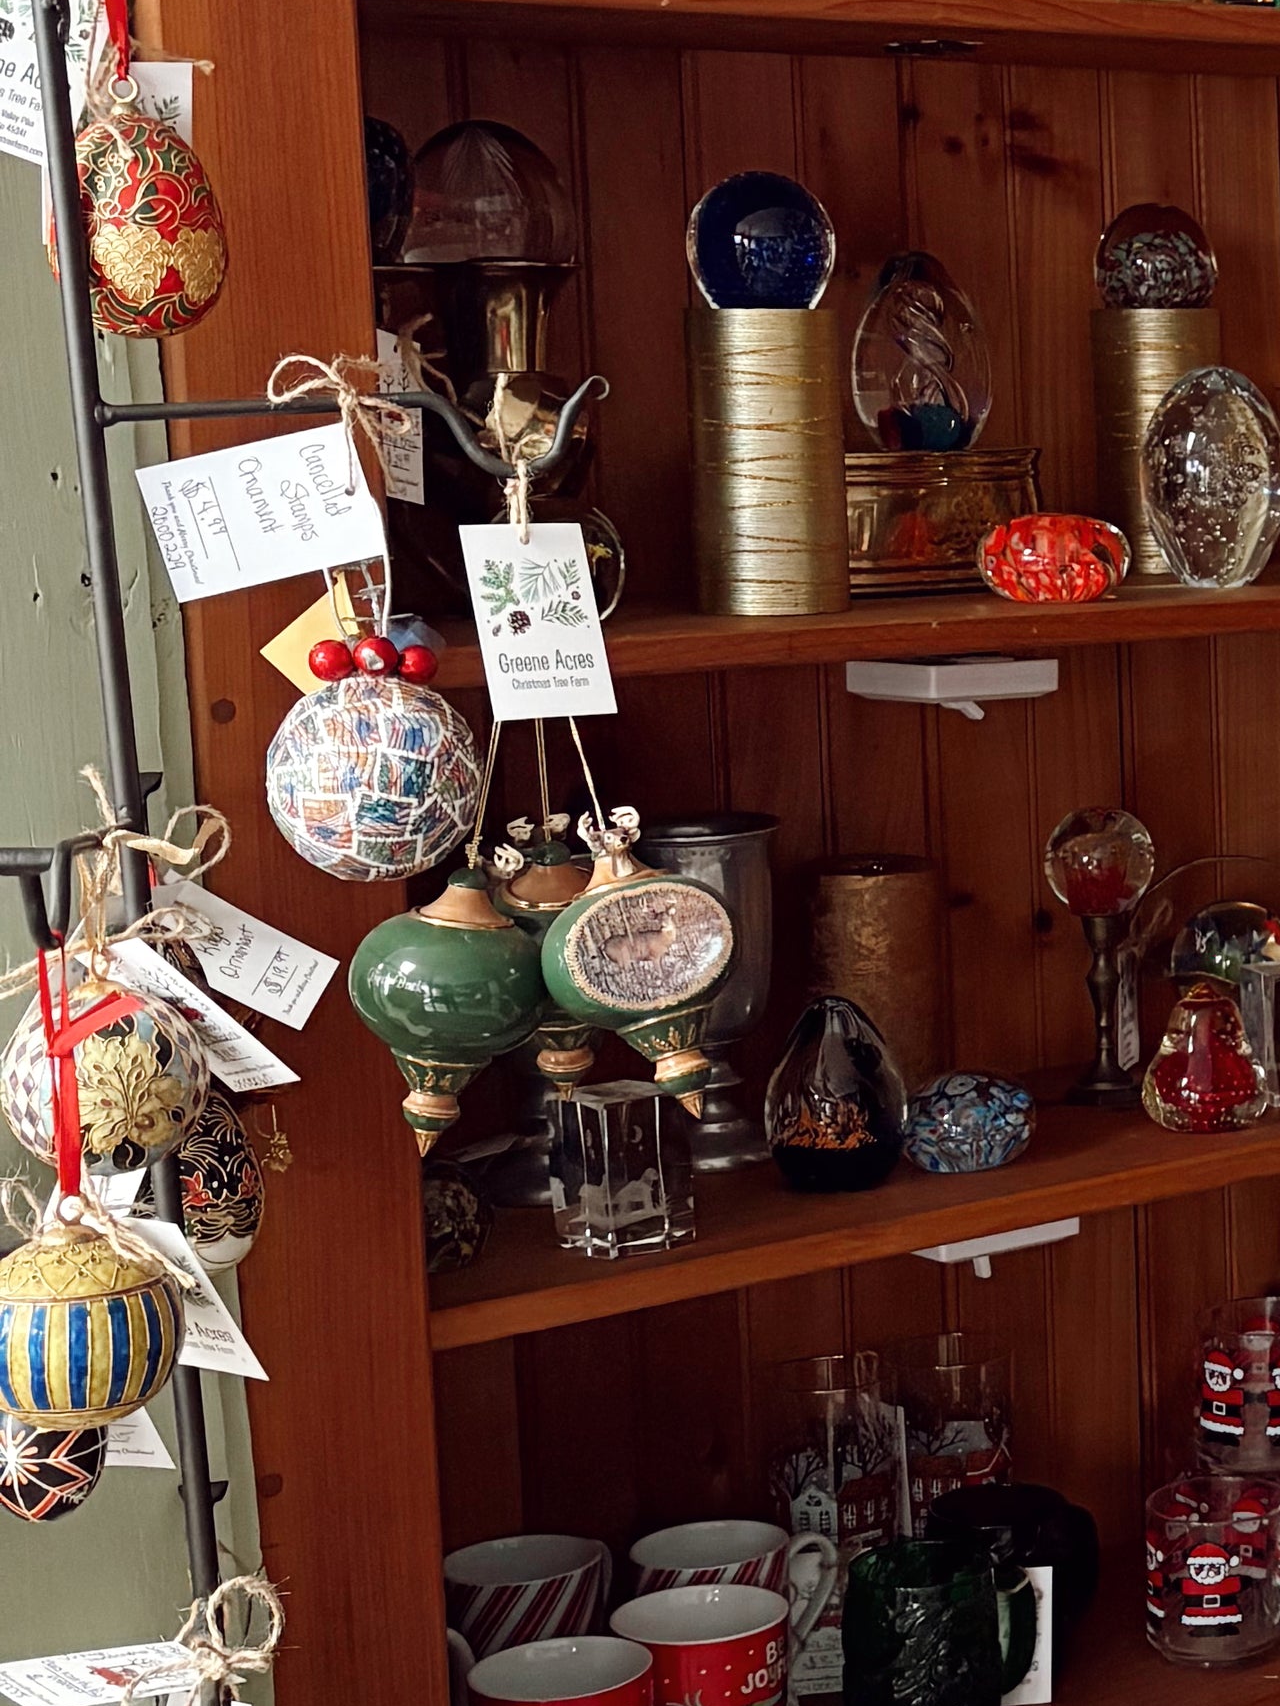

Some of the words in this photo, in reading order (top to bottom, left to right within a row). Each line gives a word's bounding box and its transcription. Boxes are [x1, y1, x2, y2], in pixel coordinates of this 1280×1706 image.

[280, 480, 319, 542] Stamps
[498, 652, 551, 674] Greene
[555, 648, 595, 671] Acres
[511, 678, 552, 690] Christmas
[552, 676, 569, 688] Tree
[570, 675, 590, 688] Farm
[194, 1321, 236, 1344] Acres
